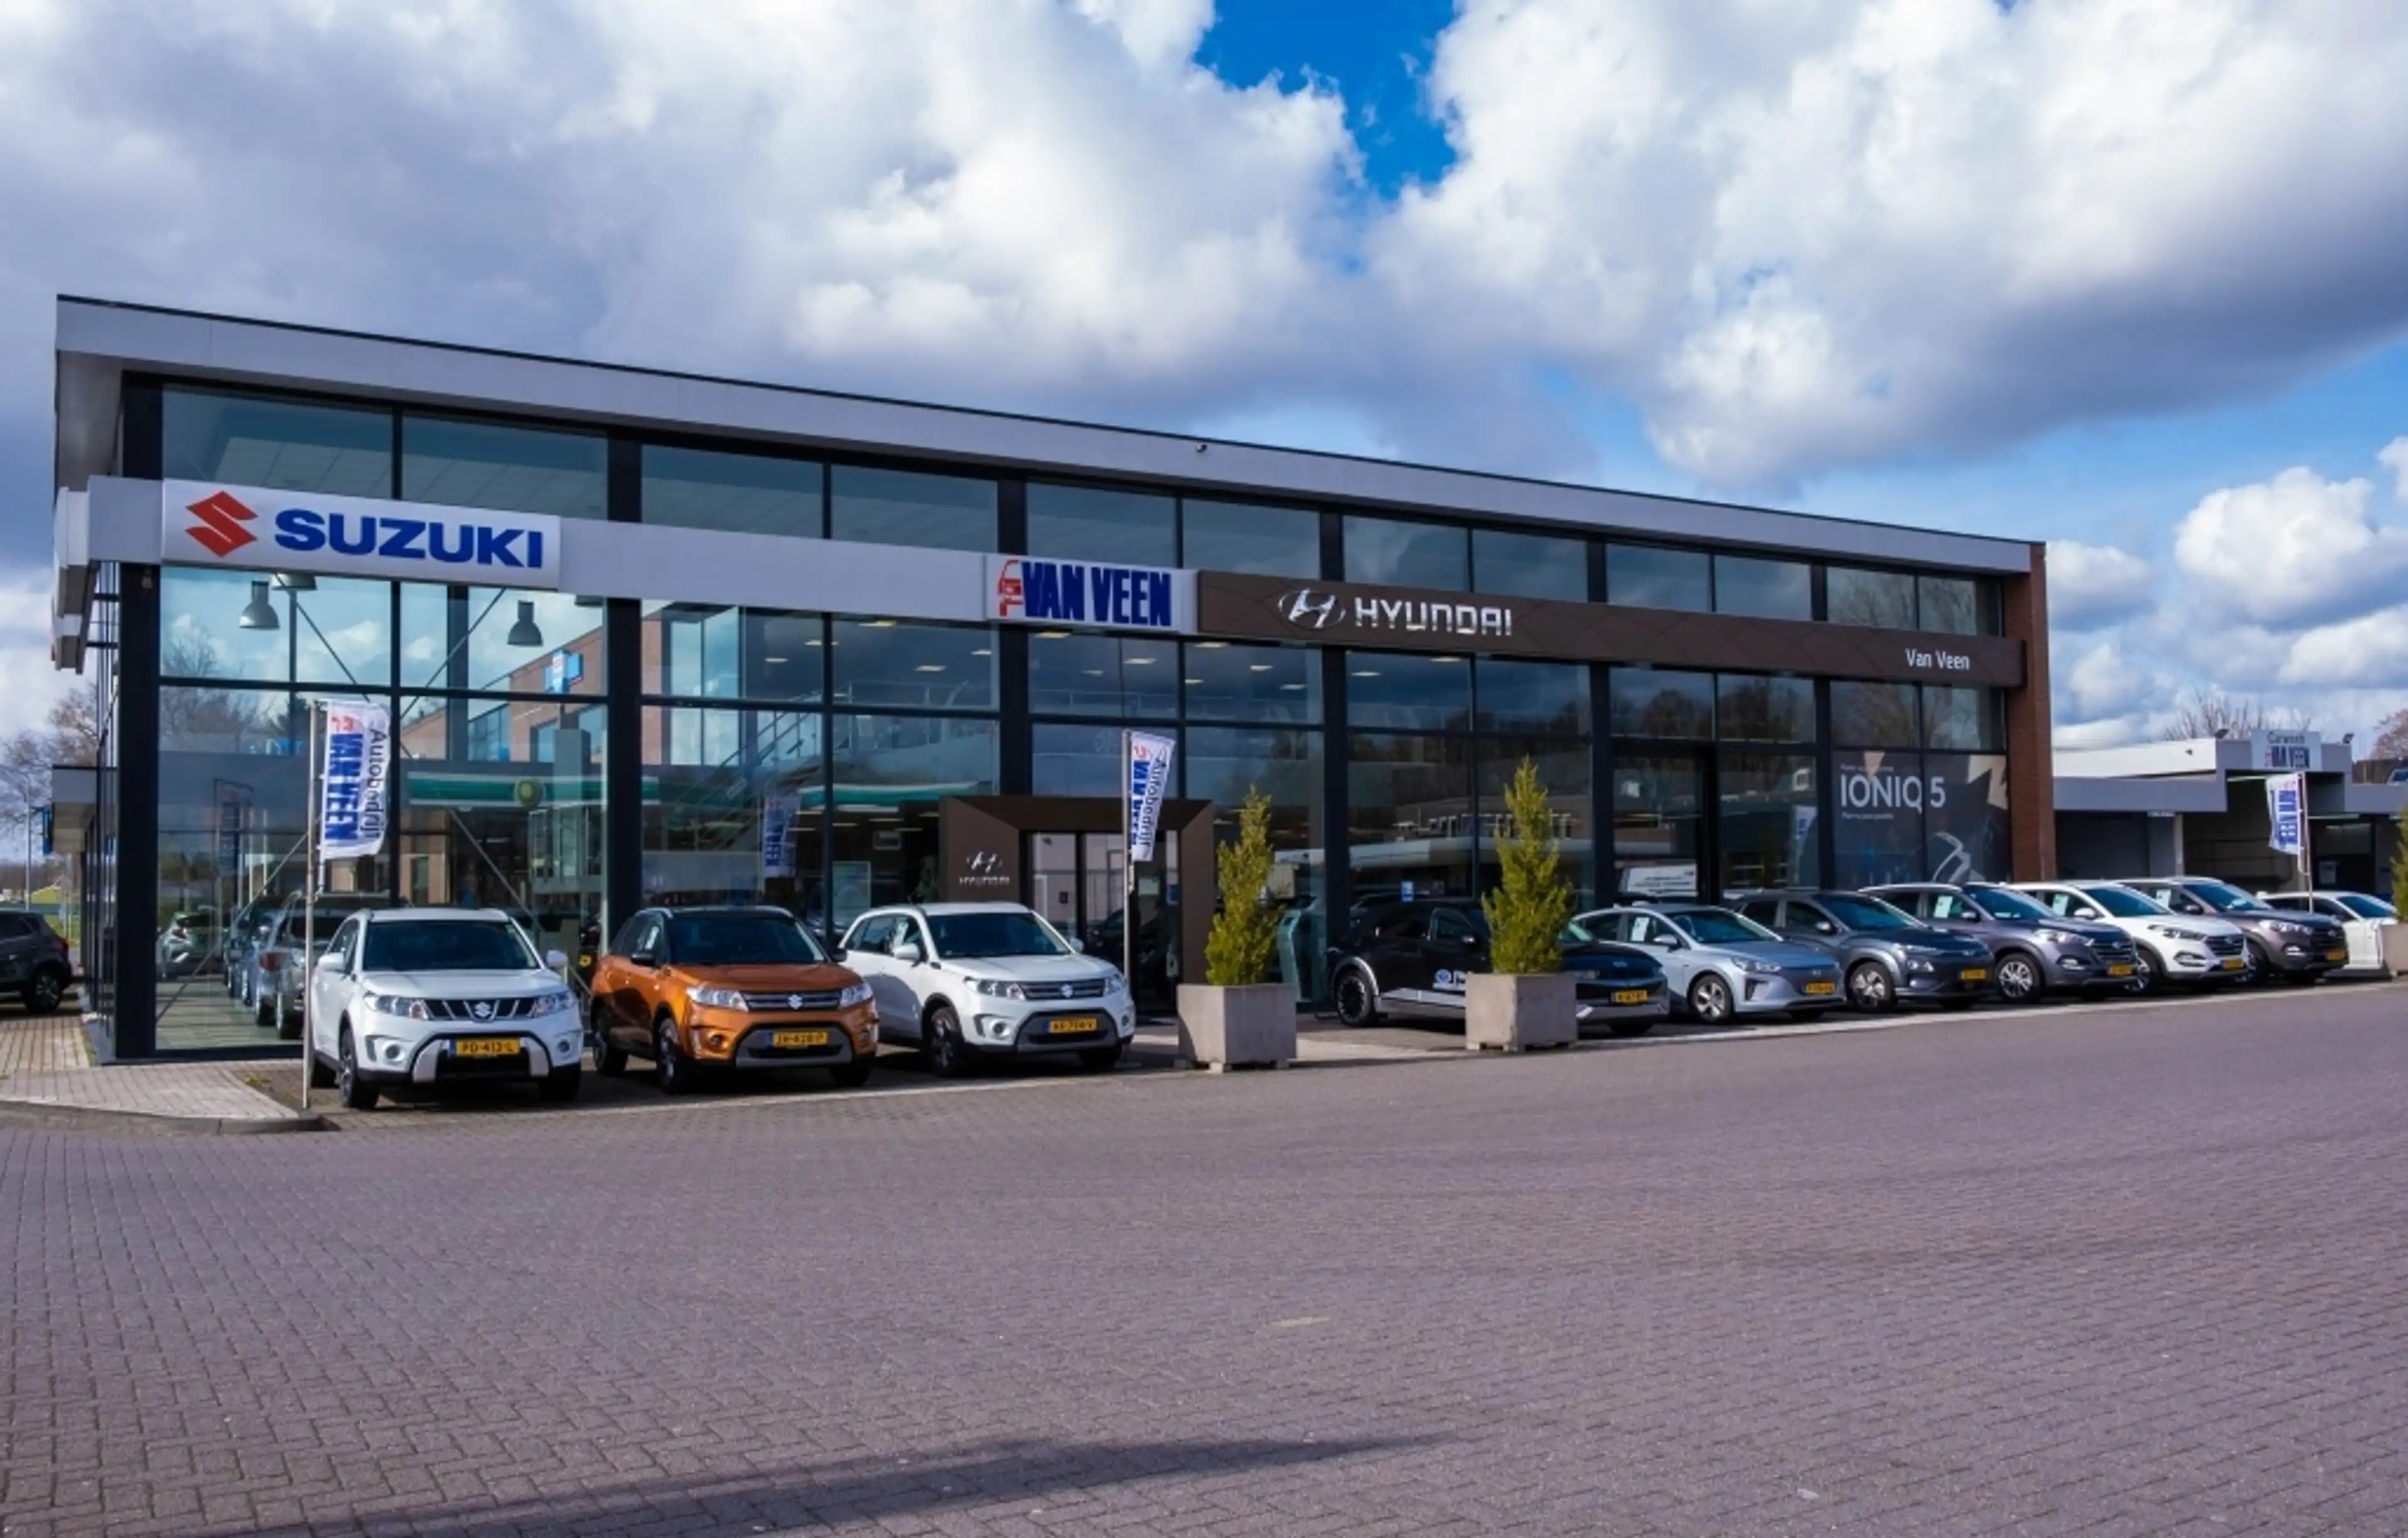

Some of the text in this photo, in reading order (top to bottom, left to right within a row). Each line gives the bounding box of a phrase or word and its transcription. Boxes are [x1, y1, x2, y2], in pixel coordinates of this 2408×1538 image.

[275, 509, 542, 568] SUZUKI
[1020, 561, 1172, 627] VAN VEEN
[1354, 596, 1513, 637] HYUNDAI
[1904, 648, 1970, 671] Van Veen
[1840, 773, 1946, 814] IONIQ 5
